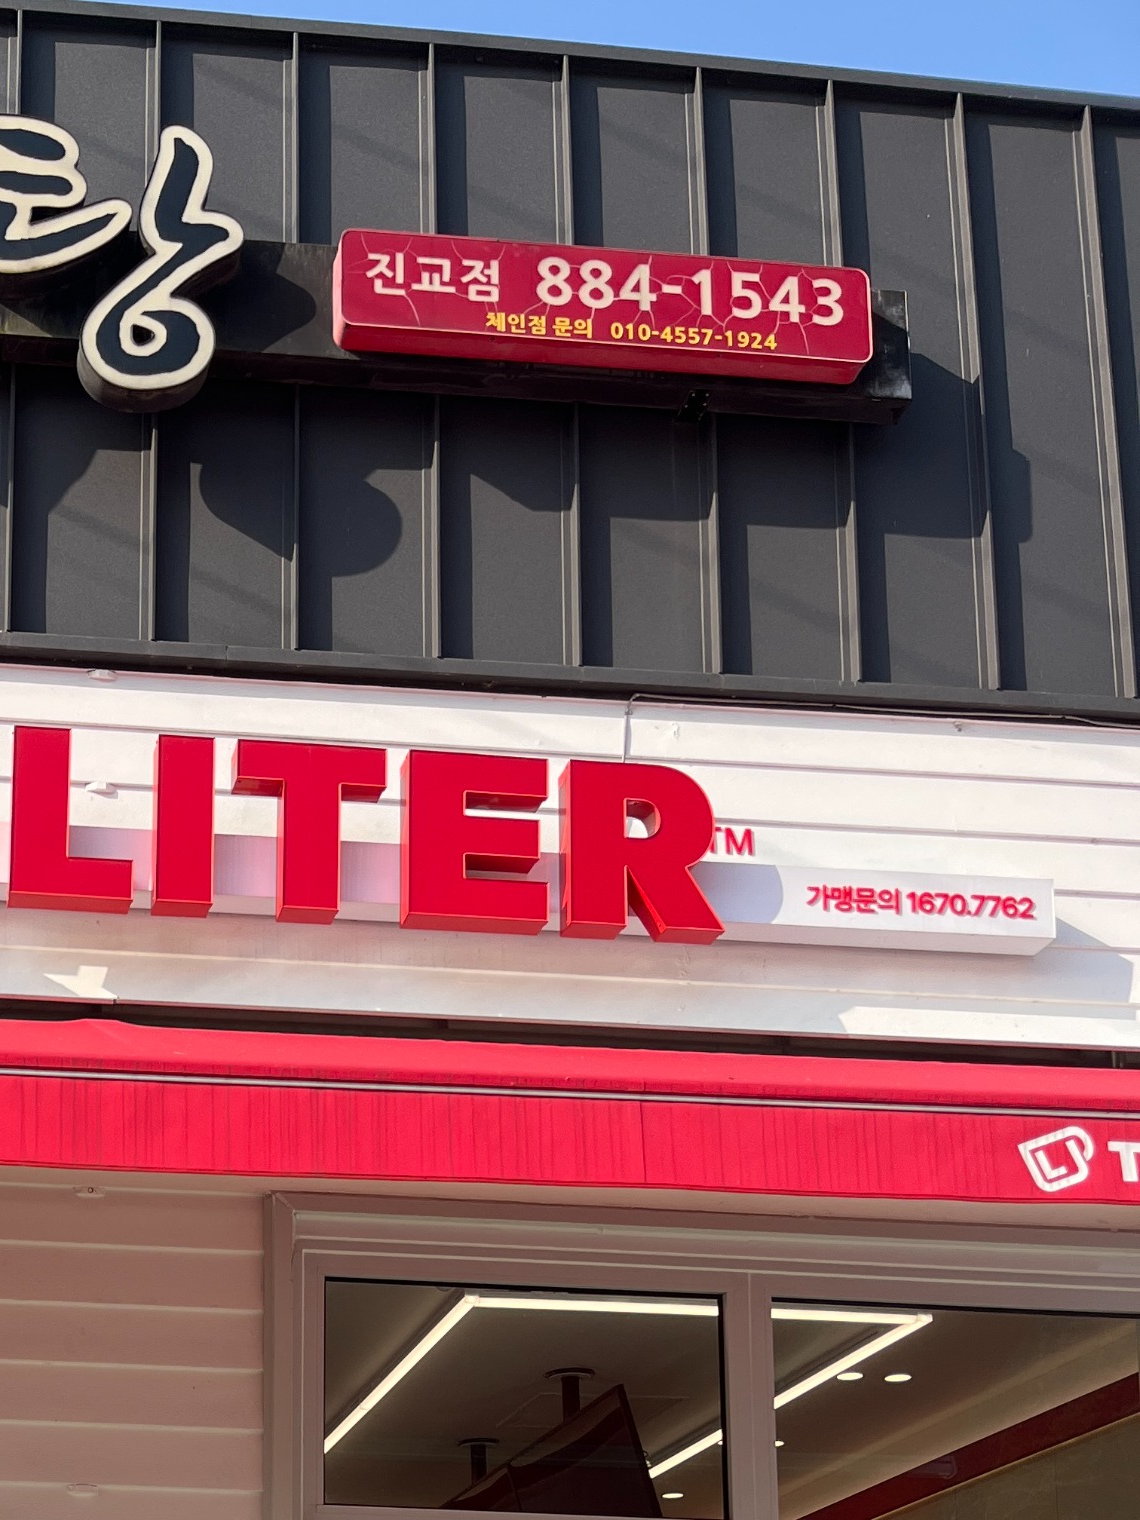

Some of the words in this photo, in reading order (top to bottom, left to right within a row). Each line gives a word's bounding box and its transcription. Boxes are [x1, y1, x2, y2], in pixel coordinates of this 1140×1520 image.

[366, 252, 500, 303] 진교점
[536, 255, 844, 326] 884-1543
[485, 311, 548, 337] 체인점
[552, 314, 593, 339] 문의
[610, 321, 778, 352] 010-4557-1924
[8, 725, 724, 942] LITER
[806, 884, 901, 915] 가맹문의
[906, 890, 1036, 920] 1670.7762
